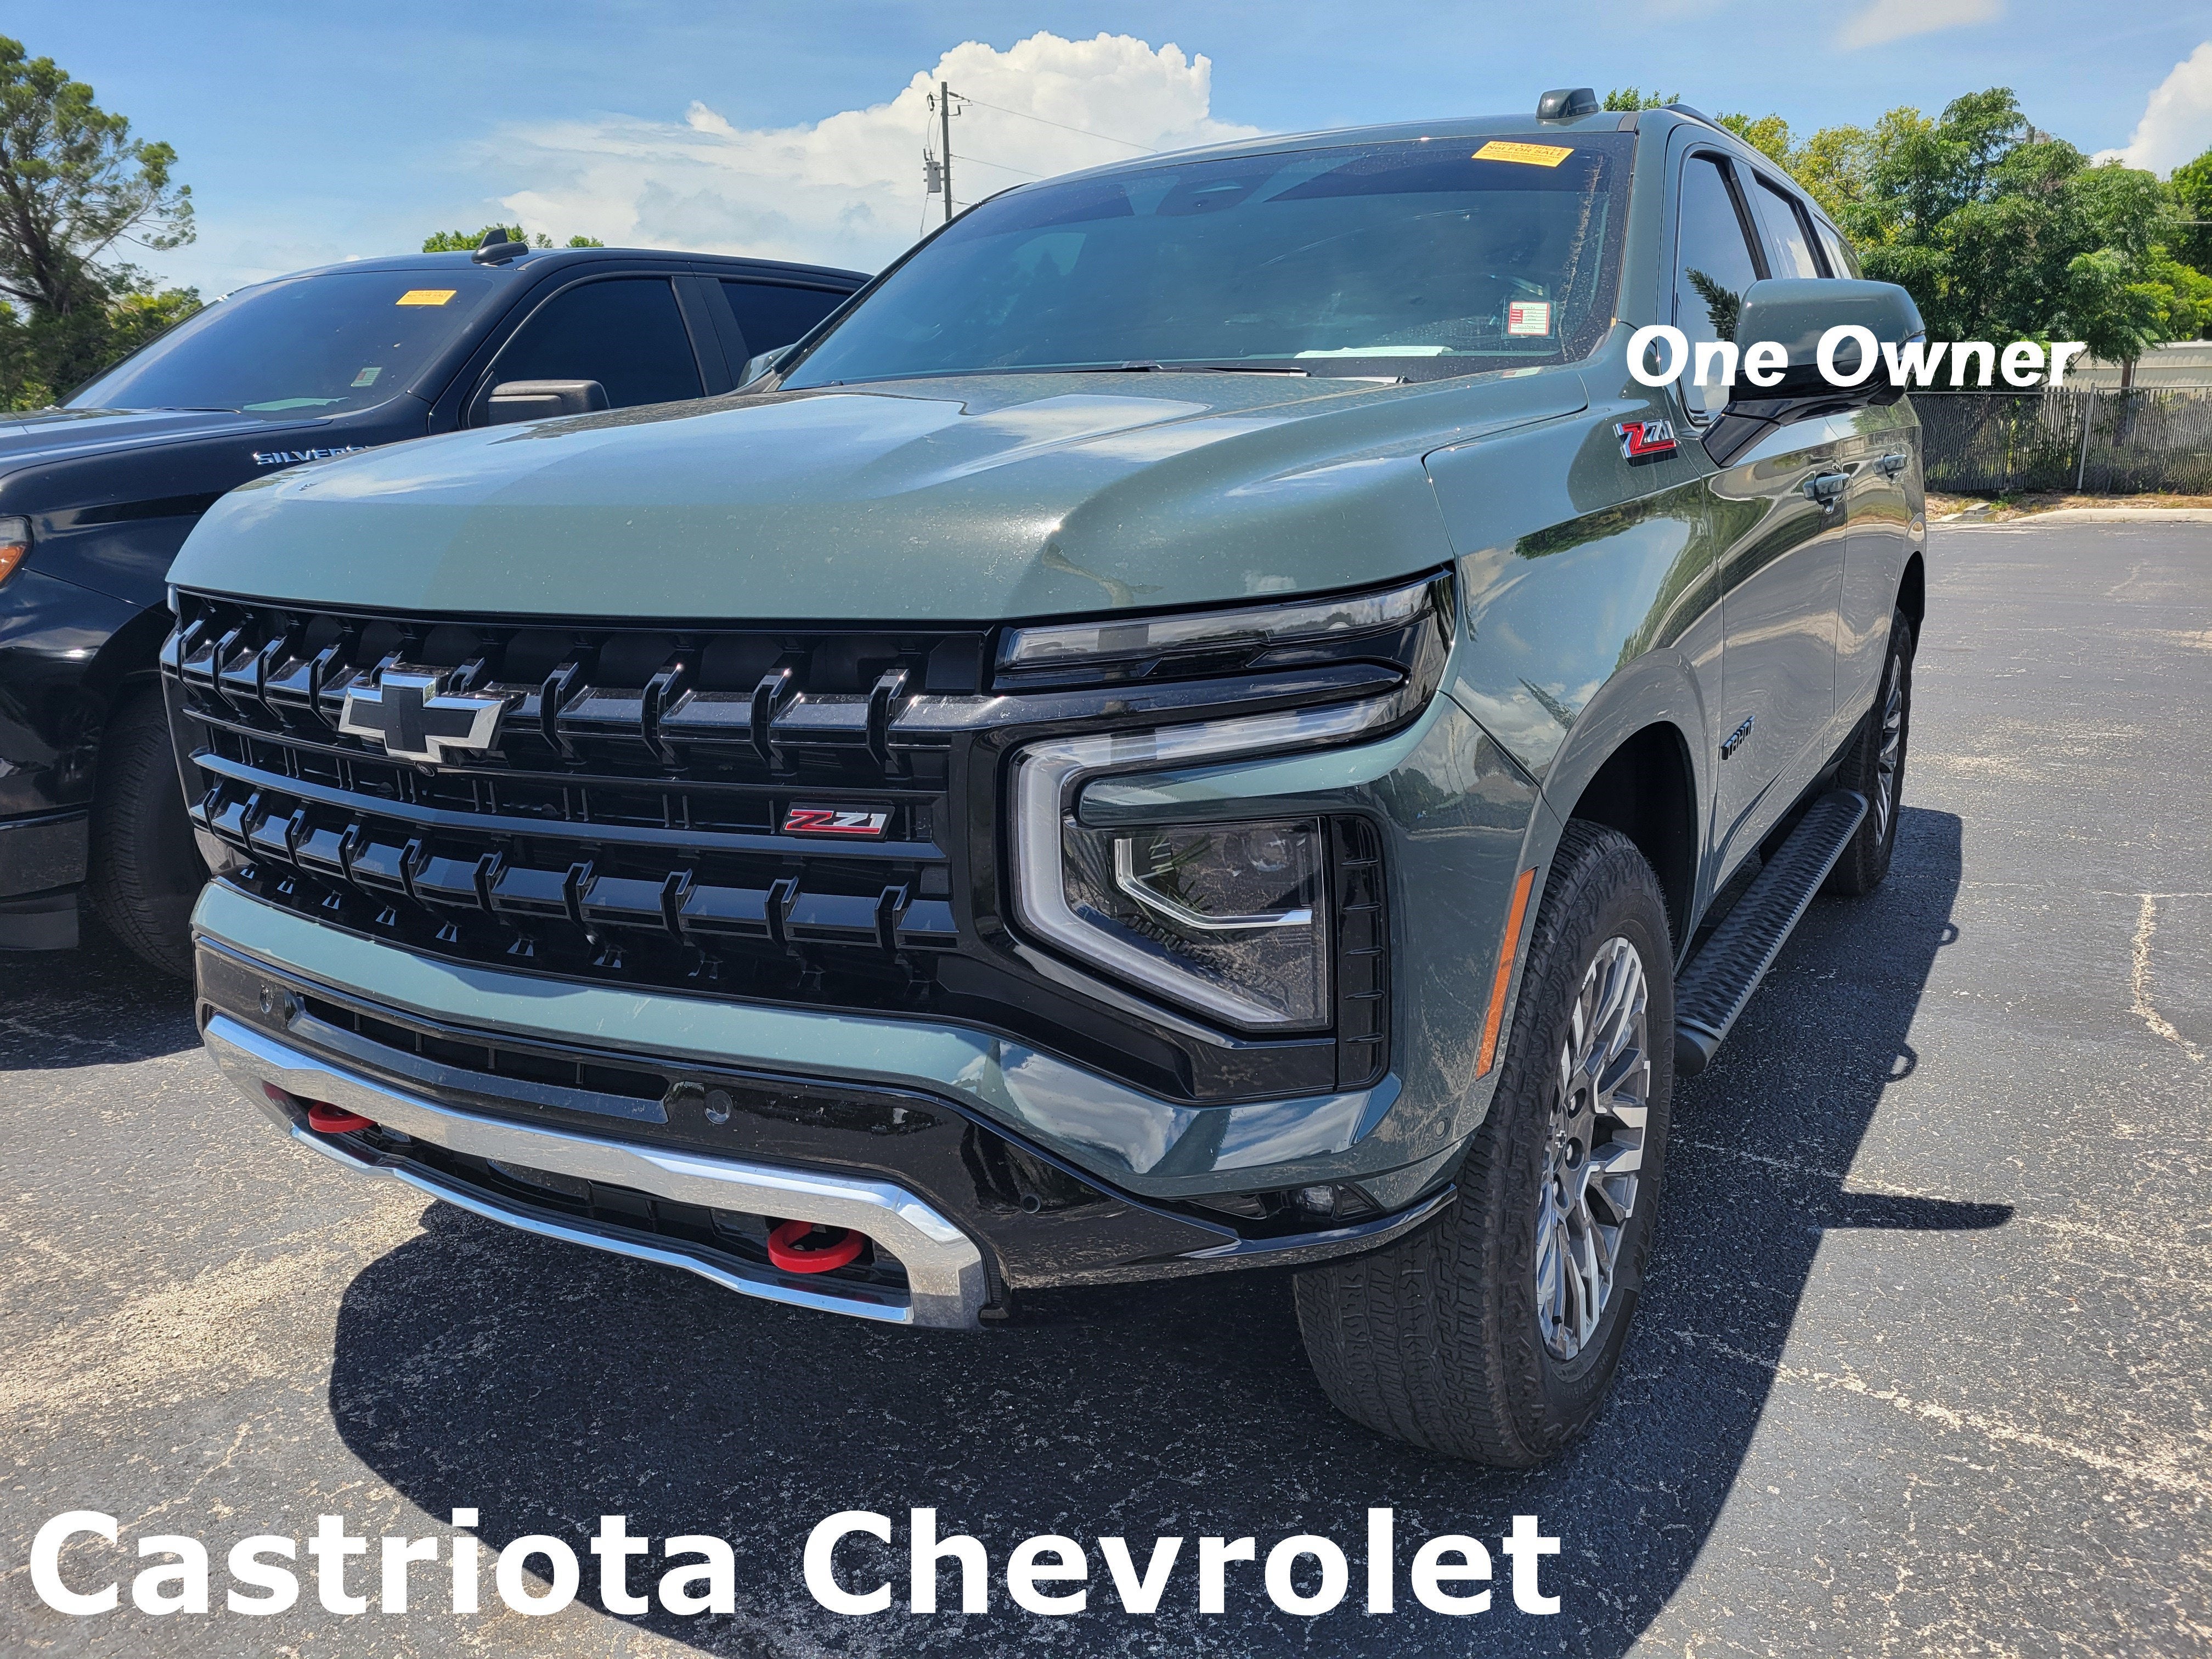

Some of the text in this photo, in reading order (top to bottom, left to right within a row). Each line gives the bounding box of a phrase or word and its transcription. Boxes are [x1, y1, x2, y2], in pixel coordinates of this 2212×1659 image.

[1520, 144, 1567, 153] VEHICLE
[1613, 419, 1678, 459] Z71
[1720, 715, 1756, 760] TAHOE
[784, 809, 888, 834] Z71
